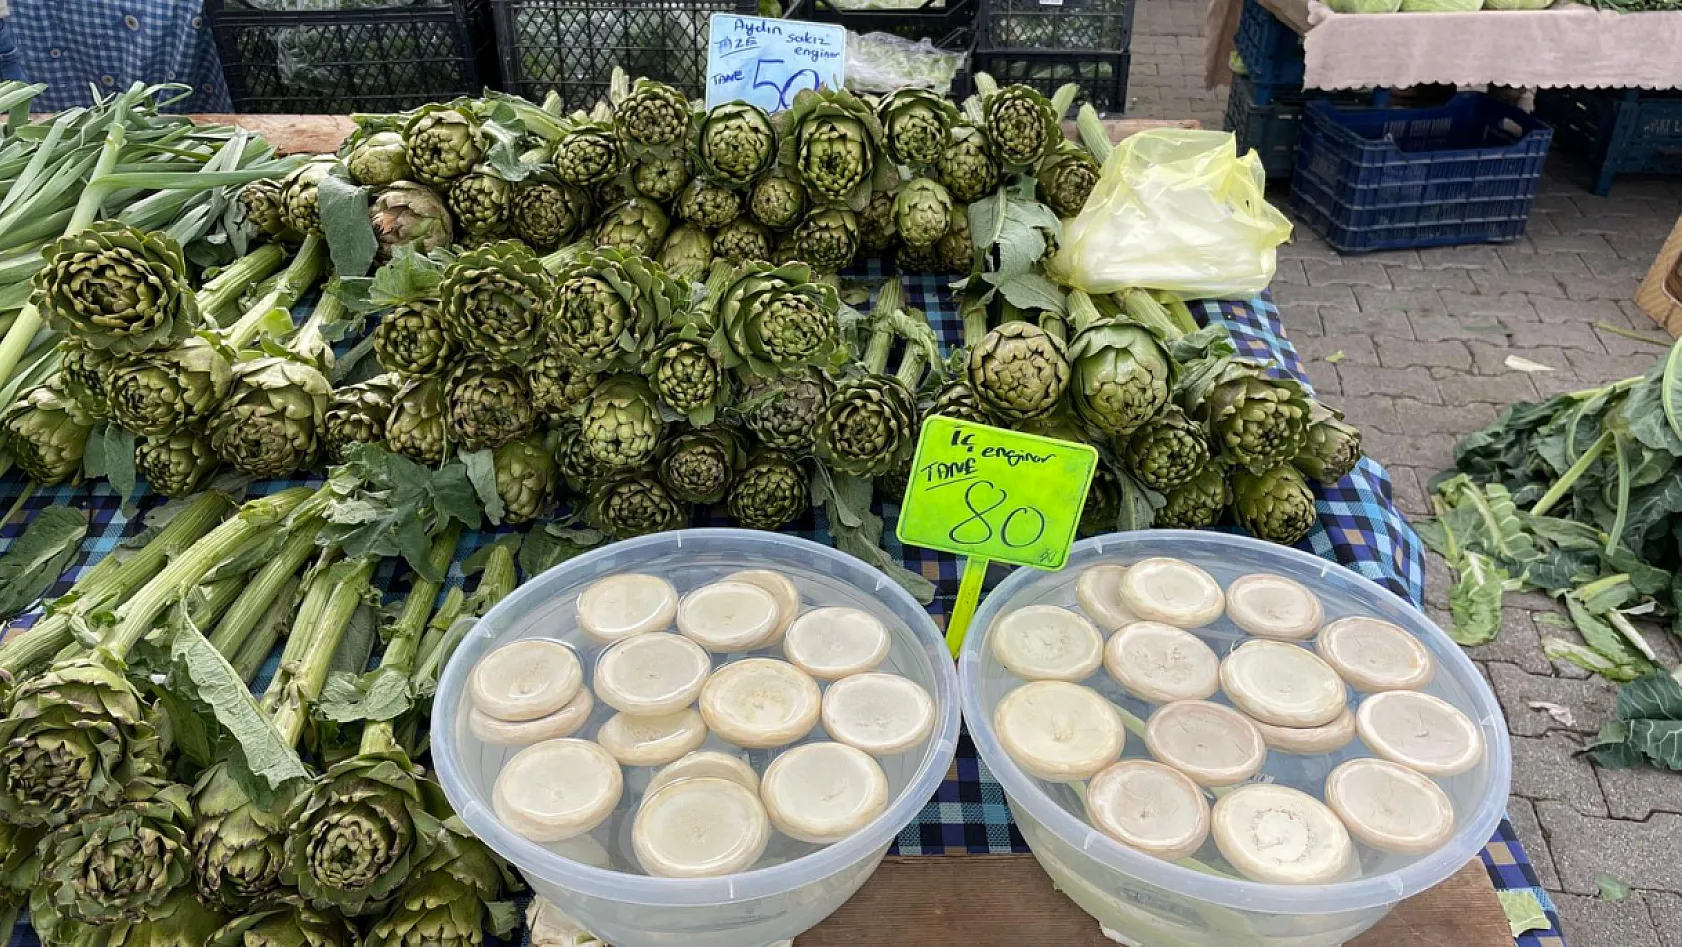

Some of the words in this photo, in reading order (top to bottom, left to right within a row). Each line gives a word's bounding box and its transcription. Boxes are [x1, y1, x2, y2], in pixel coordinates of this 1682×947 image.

[711, 70, 745, 86] TANE
[752, 58, 820, 113] 50
[920, 458, 979, 483] TANE
[948, 480, 1045, 548] 80
